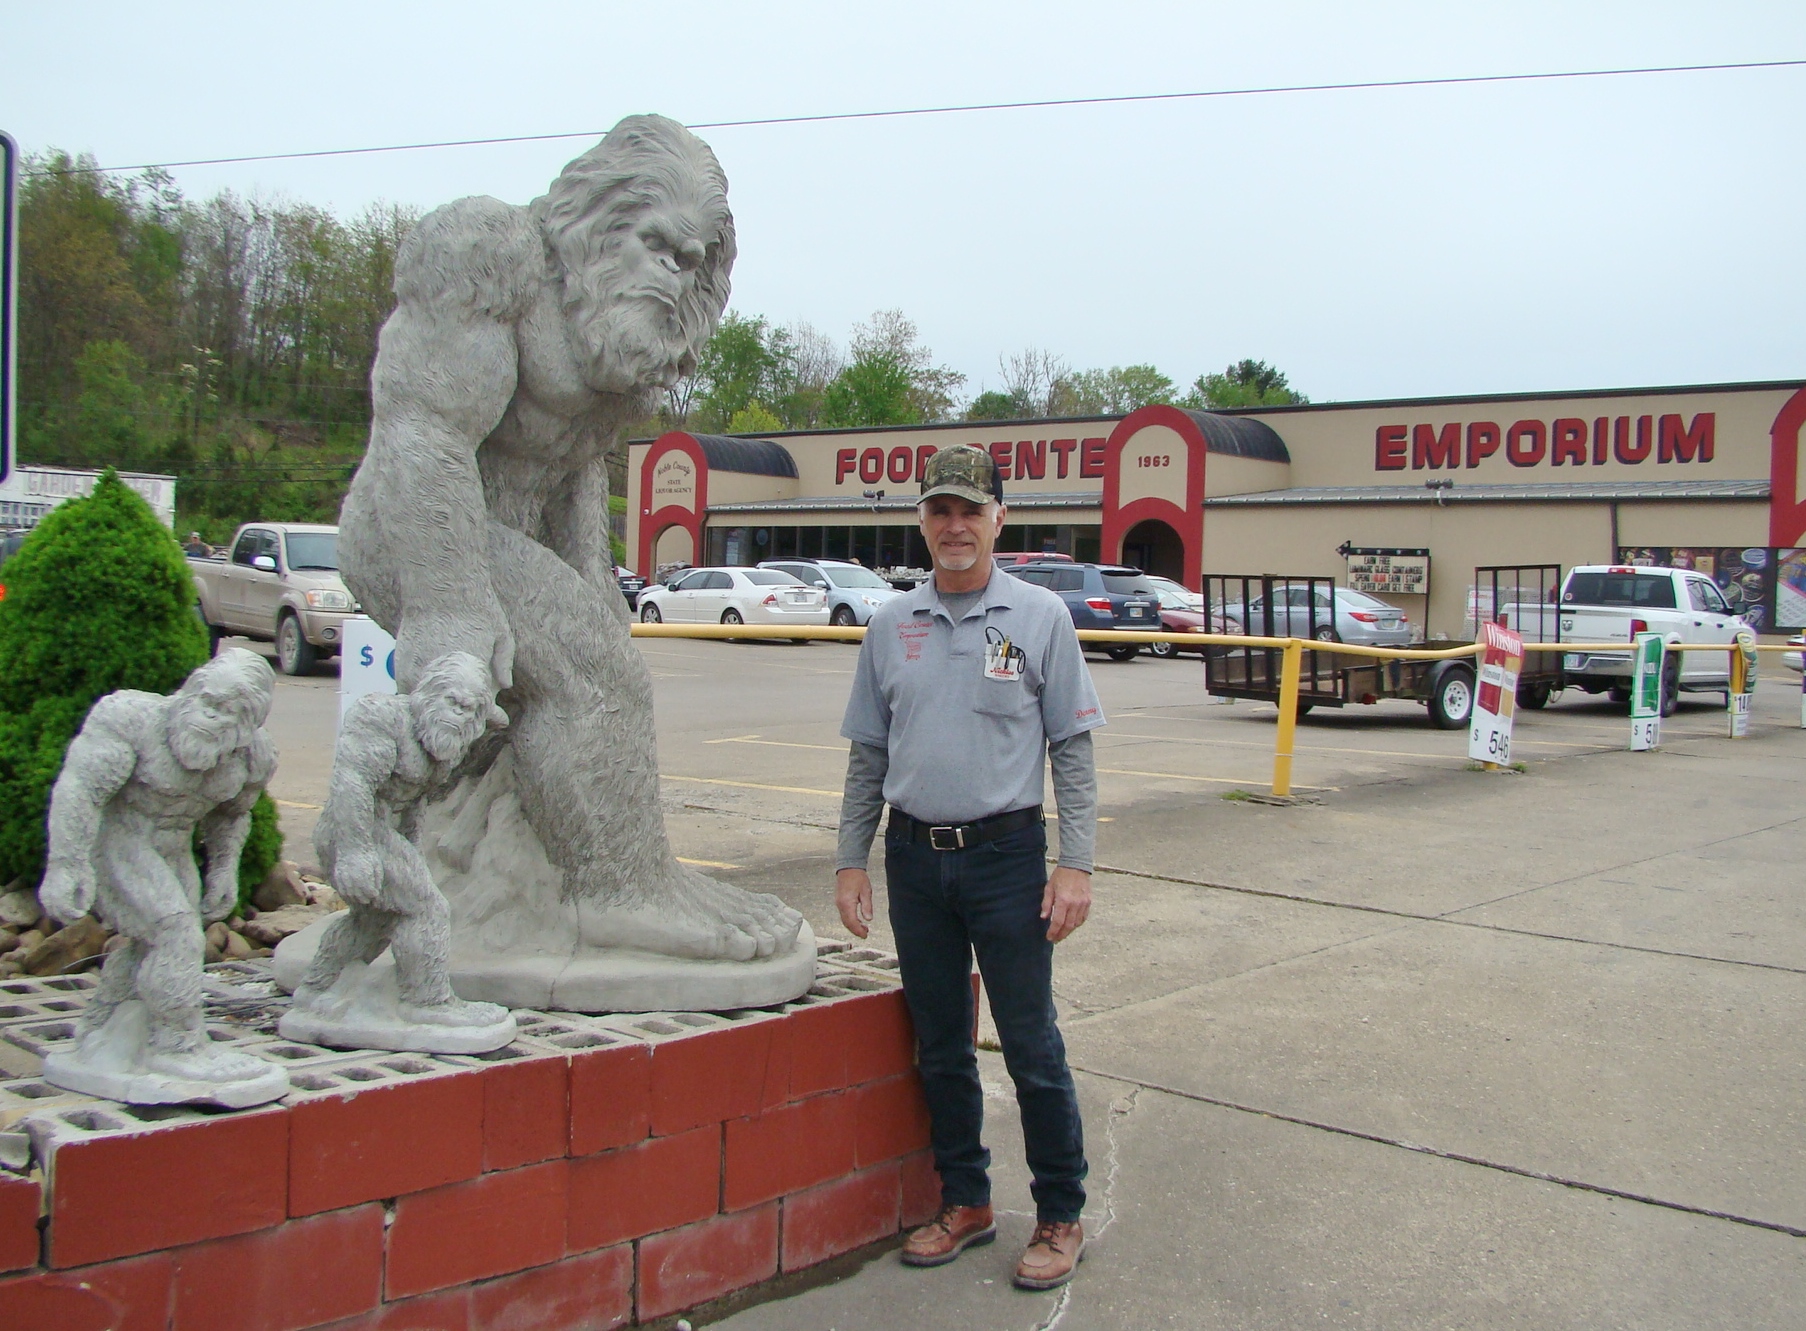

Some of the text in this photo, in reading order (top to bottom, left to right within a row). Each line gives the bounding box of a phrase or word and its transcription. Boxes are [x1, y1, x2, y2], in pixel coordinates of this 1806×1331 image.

[966, 437, 1107, 481] ENTE
[1375, 412, 1716, 471] EMPORIUM
[1137, 455, 1171, 468] 1963
[1486, 624, 1520, 656] Winston
